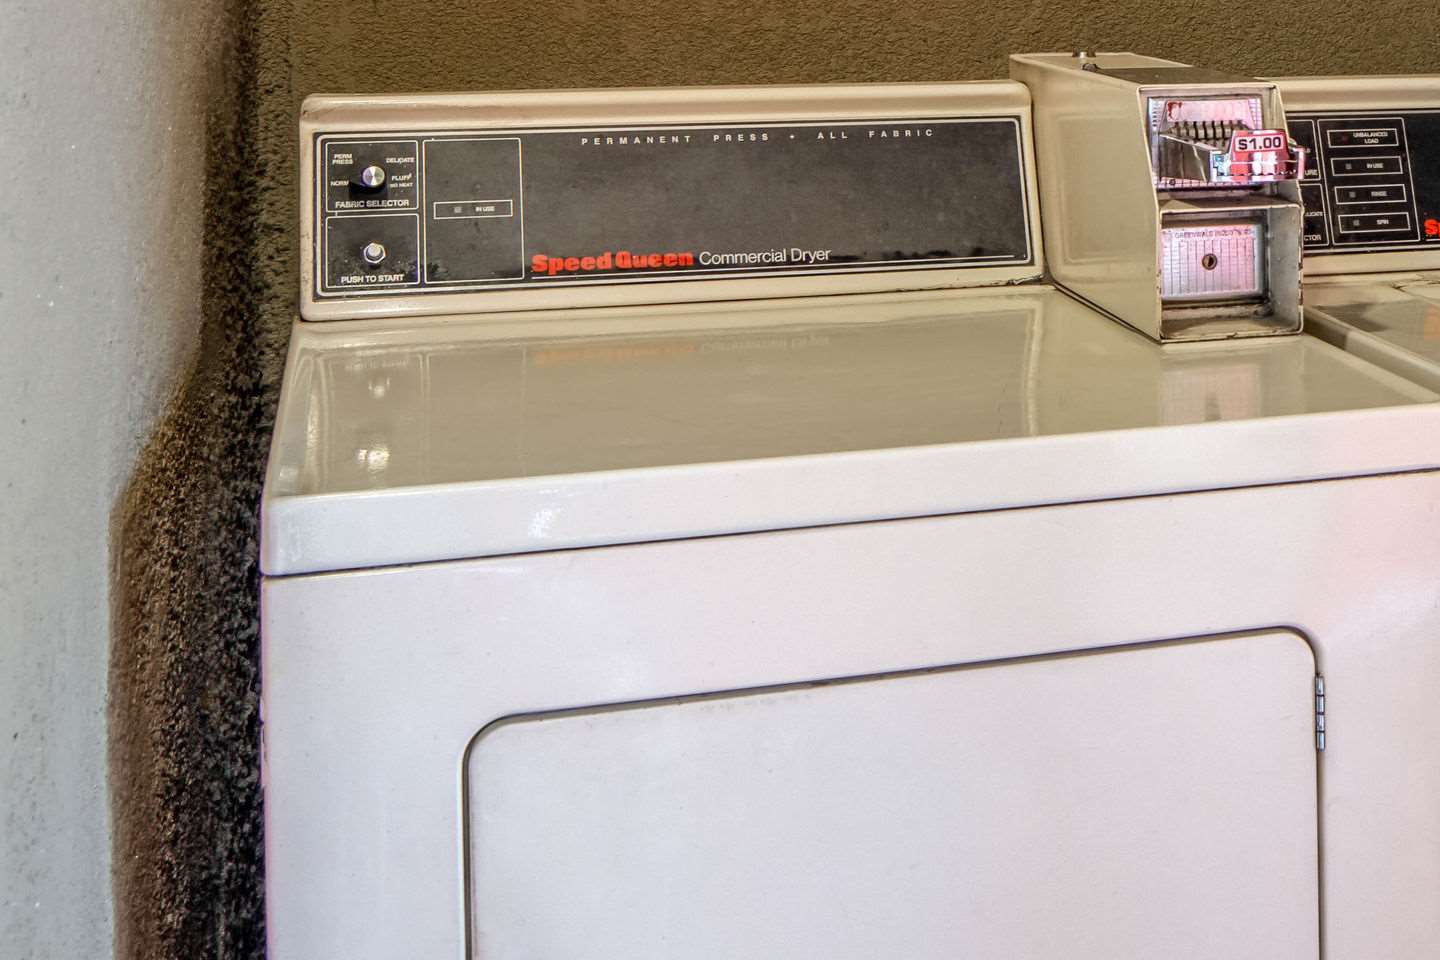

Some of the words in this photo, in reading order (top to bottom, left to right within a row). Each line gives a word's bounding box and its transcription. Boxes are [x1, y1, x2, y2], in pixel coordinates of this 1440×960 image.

[581, 135, 691, 146] PERMANENT
[713, 132, 769, 143] PRESS
[817, 130, 849, 141] ALL
[868, 128, 934, 139] FABRIC
[1238, 137, 1282, 150] $1.00
[366, 199, 410, 208] SELECTOR
[531, 252, 612, 275] Speed
[615, 250, 694, 270] Queen
[699, 249, 787, 265] Commercial
[790, 248, 832, 264] Dryer
[341, 275, 364, 283] PUSH
[365, 274, 377, 282] TO
[378, 274, 405, 282] START
